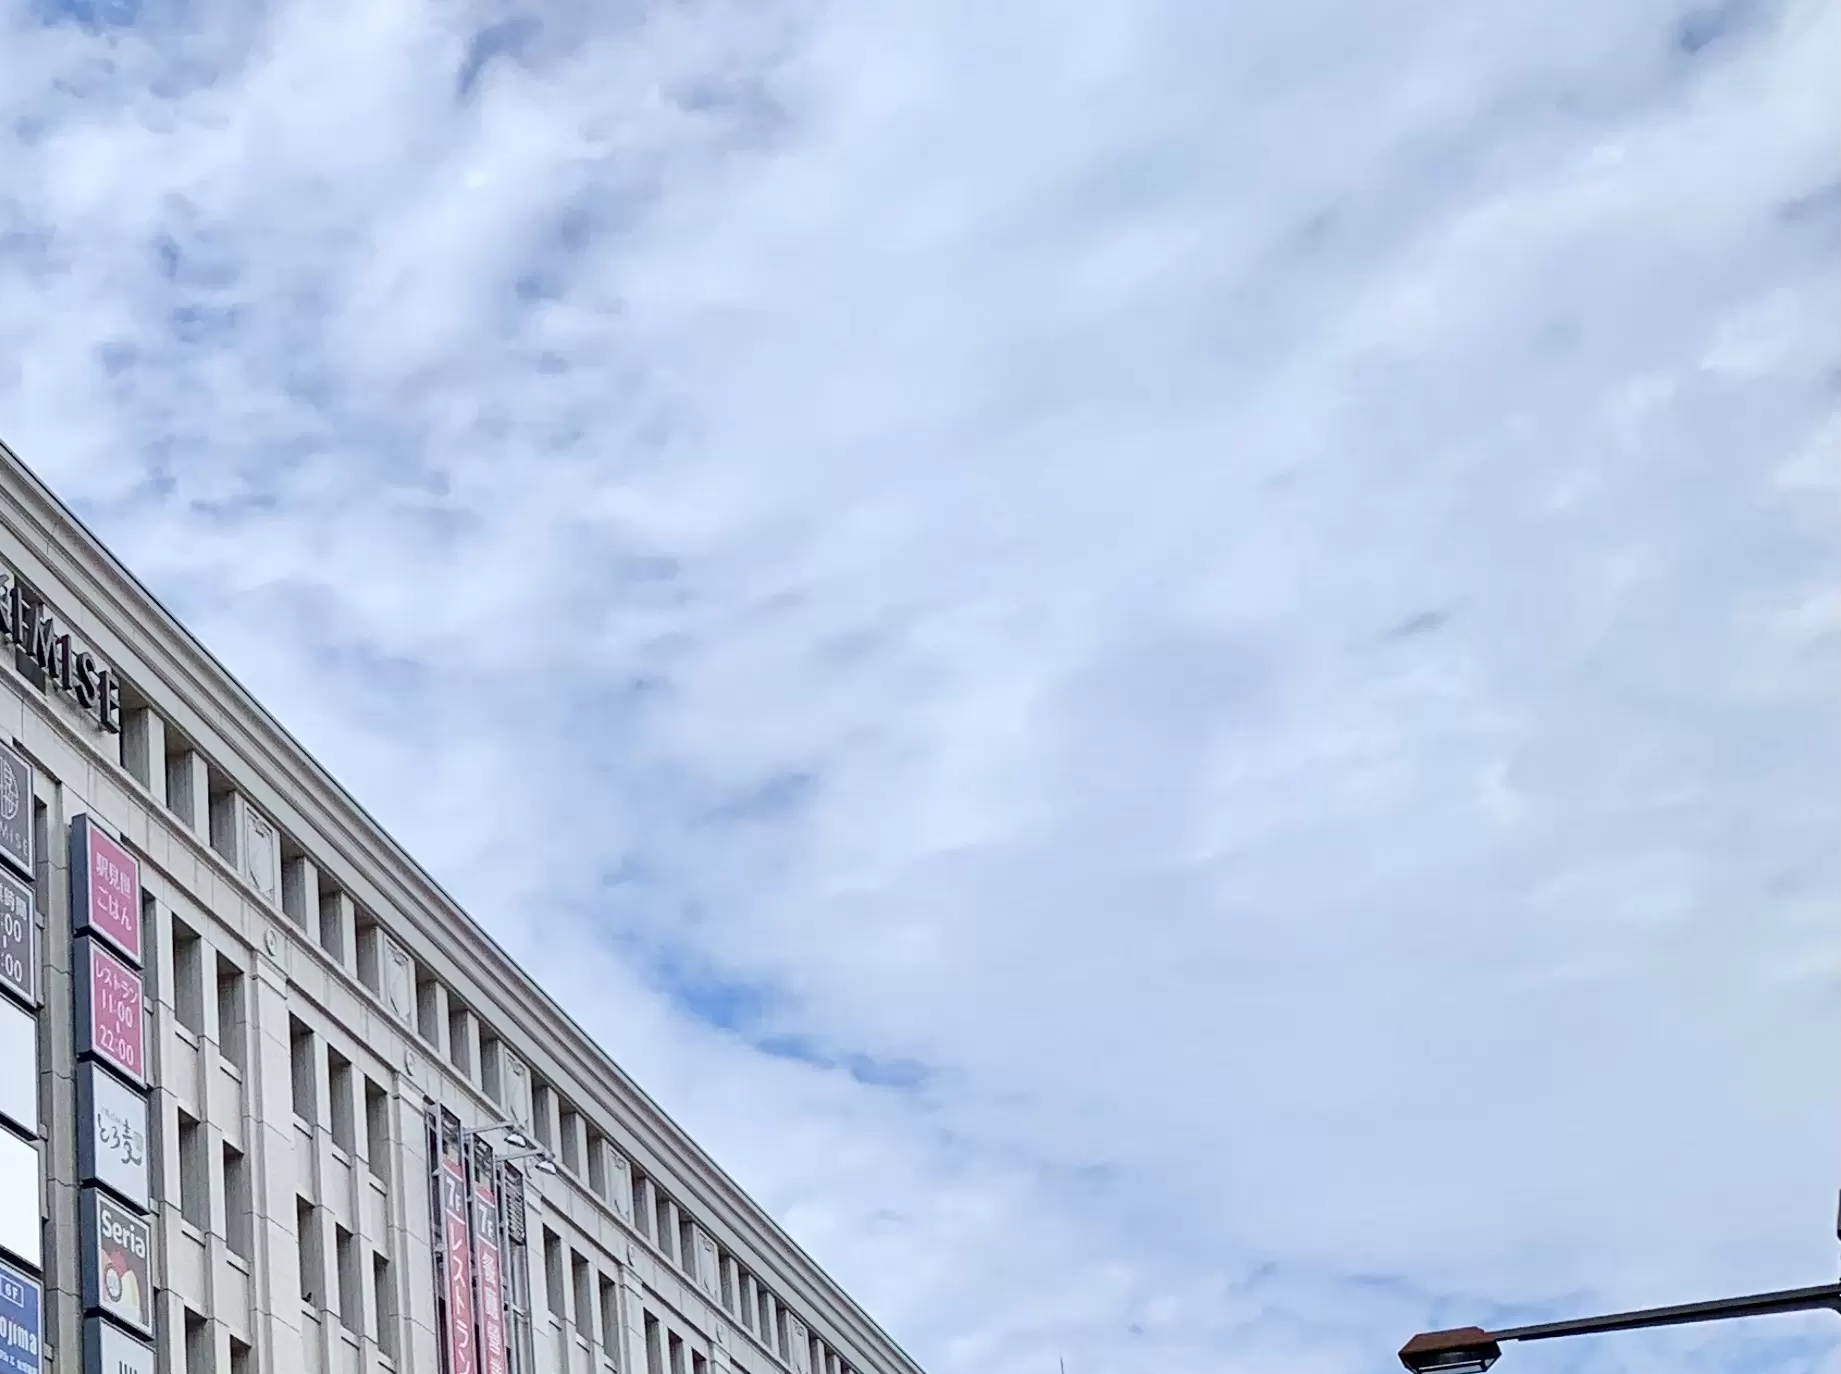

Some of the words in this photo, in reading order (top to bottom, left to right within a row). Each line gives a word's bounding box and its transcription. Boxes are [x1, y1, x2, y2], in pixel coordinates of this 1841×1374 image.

[97, 886, 133, 931] ごはん
[95, 960, 138, 1003] レストラン
[101, 989, 133, 1023] 11:00
[99, 1025, 134, 1066] 22:00
[101, 1209, 146, 1260] Seria
[5, 1282, 19, 1300] 6F
